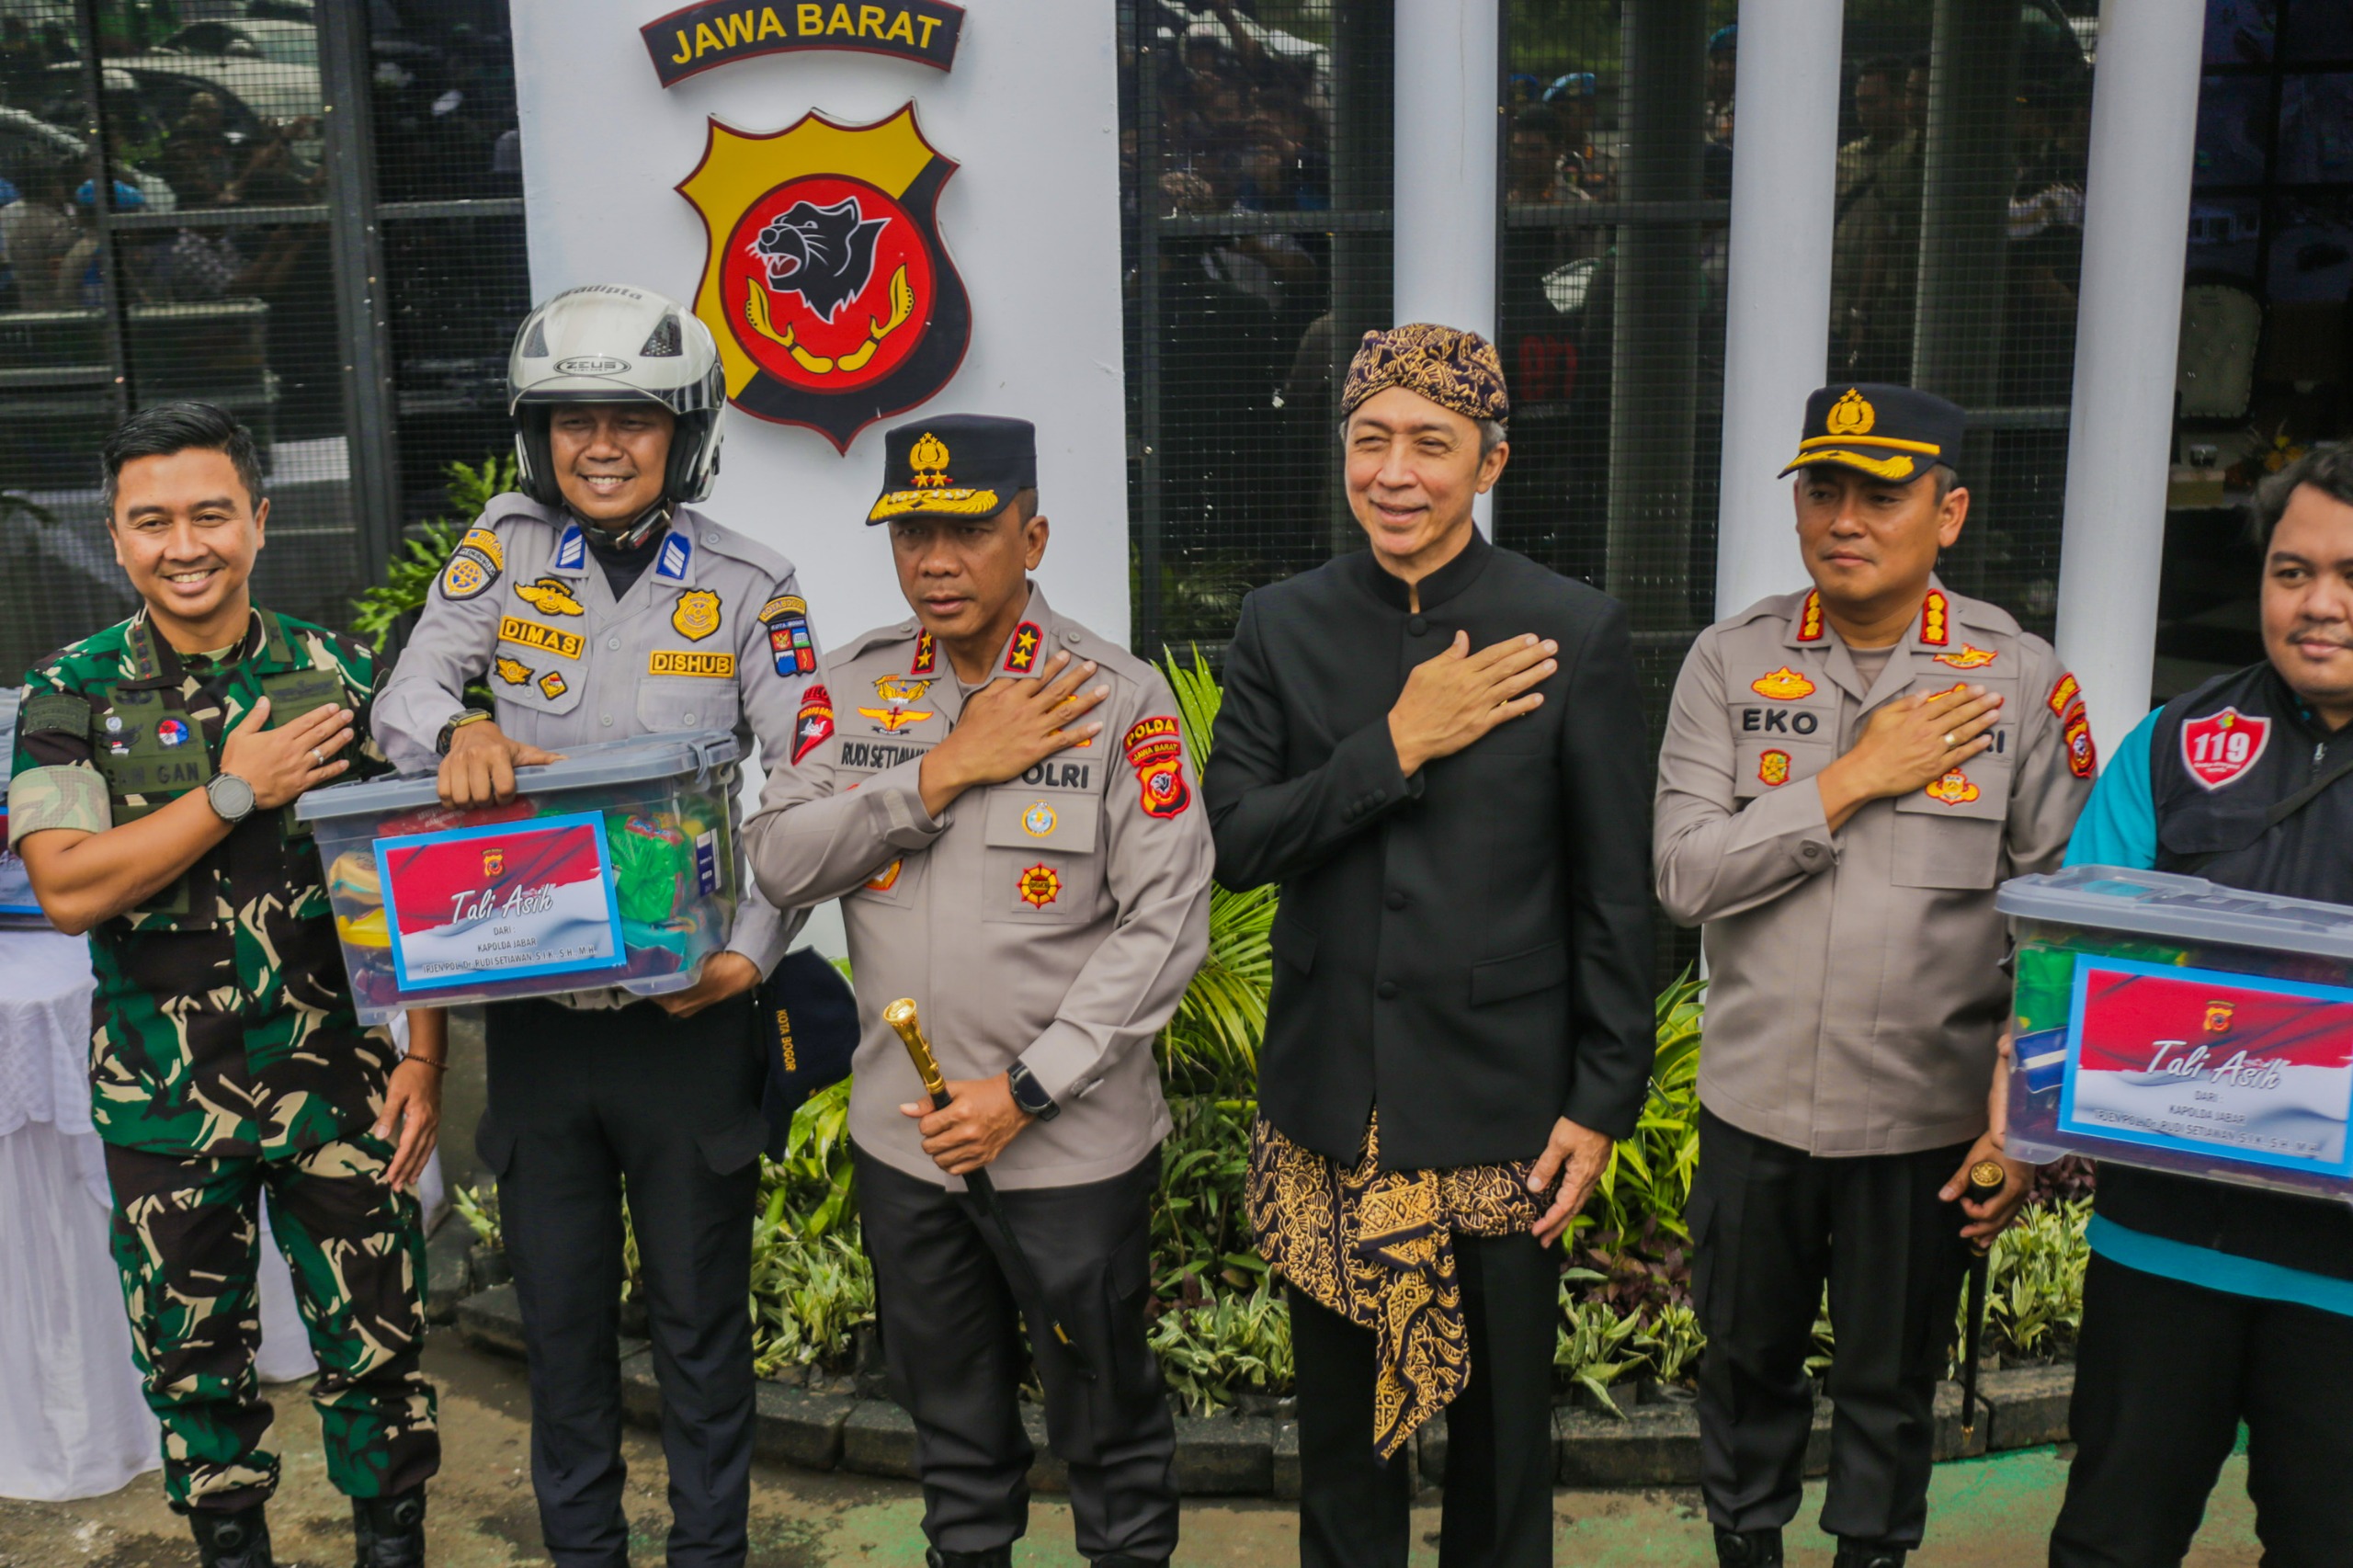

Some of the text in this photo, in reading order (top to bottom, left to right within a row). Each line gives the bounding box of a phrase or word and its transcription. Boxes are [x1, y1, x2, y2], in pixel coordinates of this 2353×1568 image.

[671, 3, 942, 64] JAWA BARAT
[566, 361, 616, 369] ZEUS
[505, 620, 576, 653] DIMAS
[654, 654, 731, 674] DISHUB
[1127, 719, 1176, 746] POLDA
[1743, 708, 1818, 734] EKO
[841, 742, 870, 767] RUDI
[1133, 744, 1177, 762] JAWA BARAT
[2193, 732, 2250, 763] 119
[157, 762, 199, 783] GAN
[1020, 762, 1089, 789] OLRI
[450, 883, 552, 925] Tali Asih
[494, 926, 511, 936] DARI
[477, 937, 537, 953] KAPOLDA JABAR
[475, 958, 494, 968] RUDI
[776, 1008, 797, 1072] KOTA BOGOR
[2146, 1040, 2281, 1089] Tali Asih
[2194, 1090, 2218, 1102] DARI
[2168, 1105, 2246, 1123] KAPOLDA JABAR
